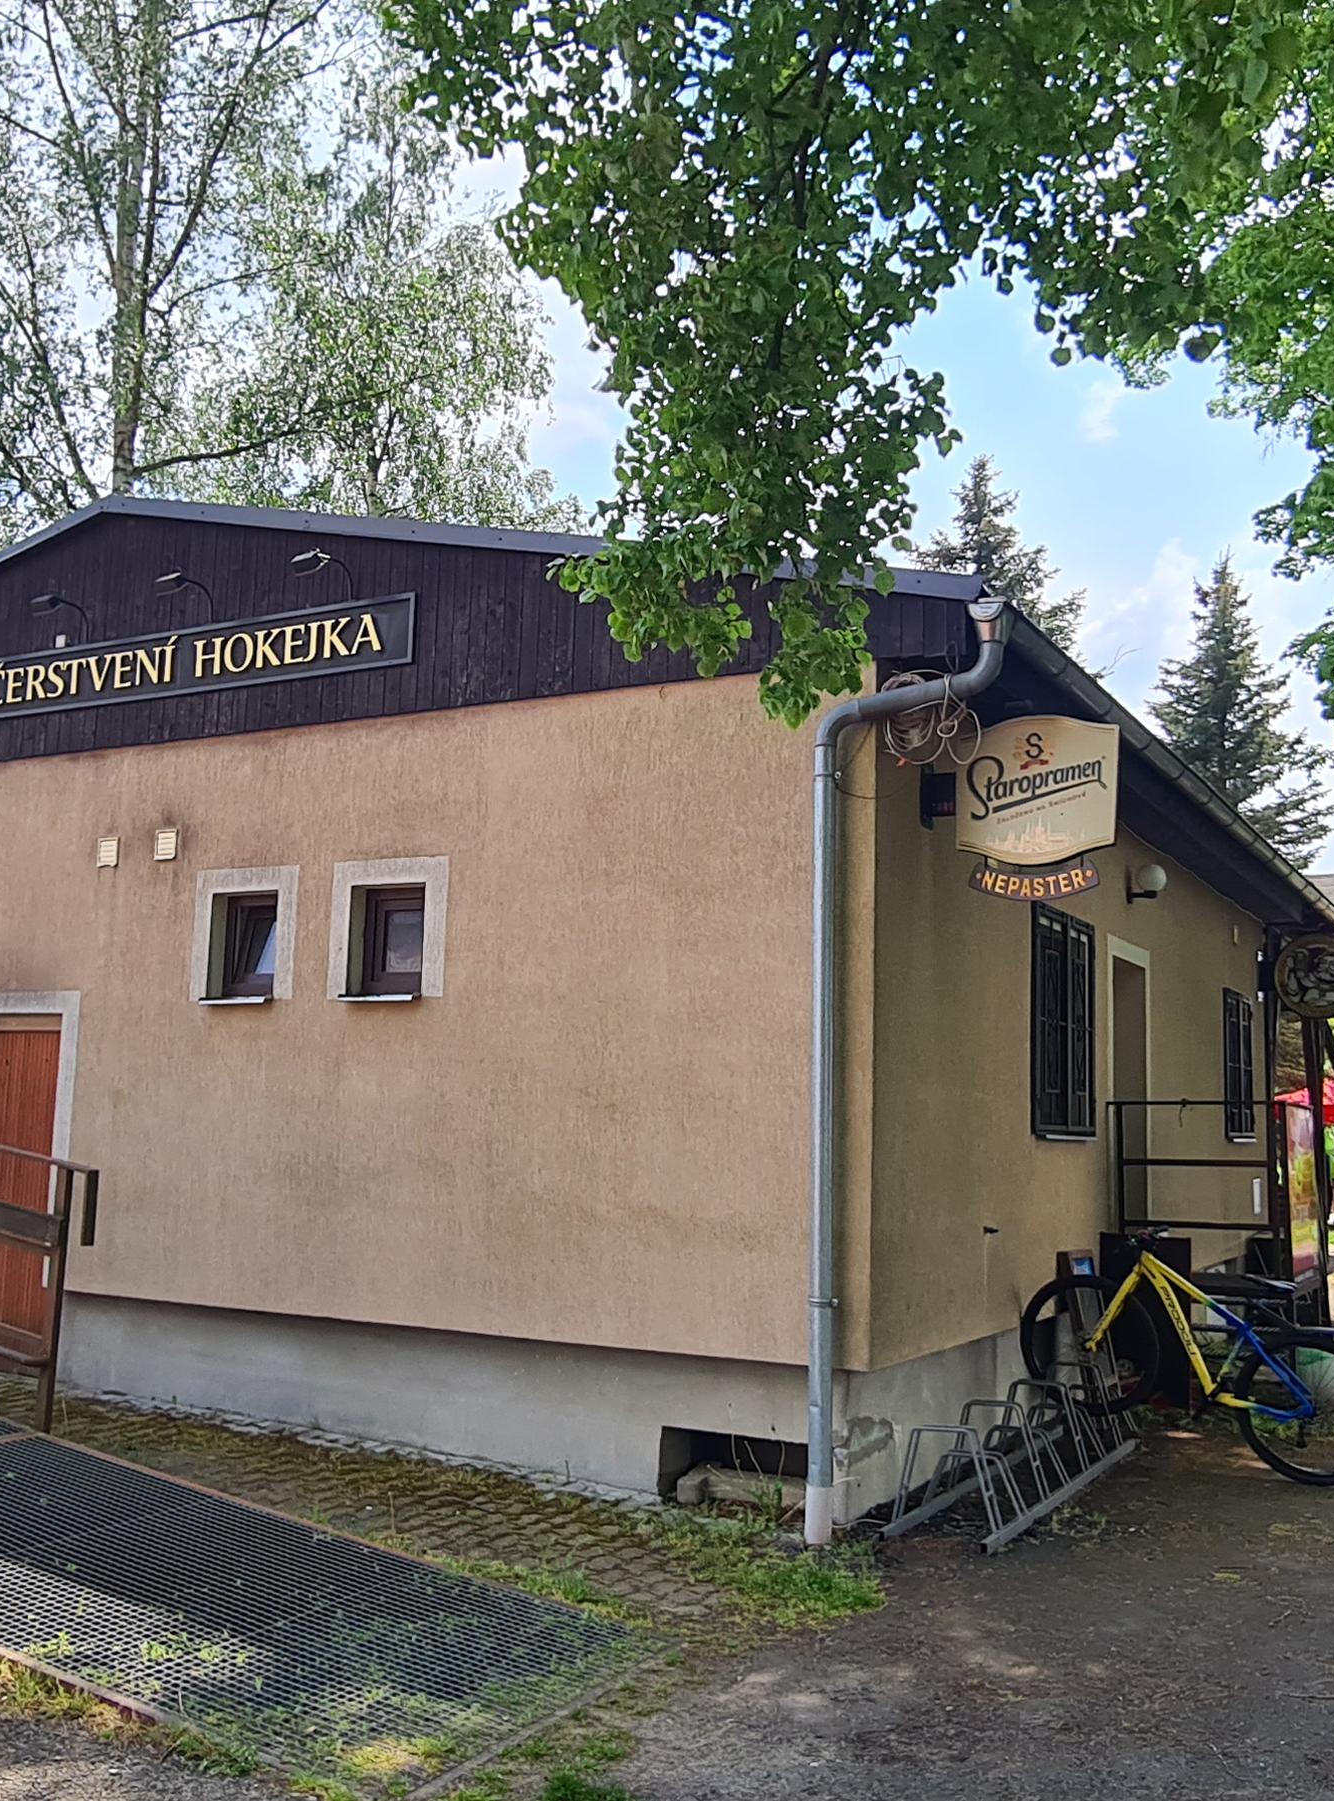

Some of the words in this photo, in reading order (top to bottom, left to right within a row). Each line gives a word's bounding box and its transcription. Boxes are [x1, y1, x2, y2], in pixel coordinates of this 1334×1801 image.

[193, 613, 382, 678] HOKEJKA
[966, 755, 1105, 820] Staropramen
[981, 868, 1087, 897] NEPASTER
